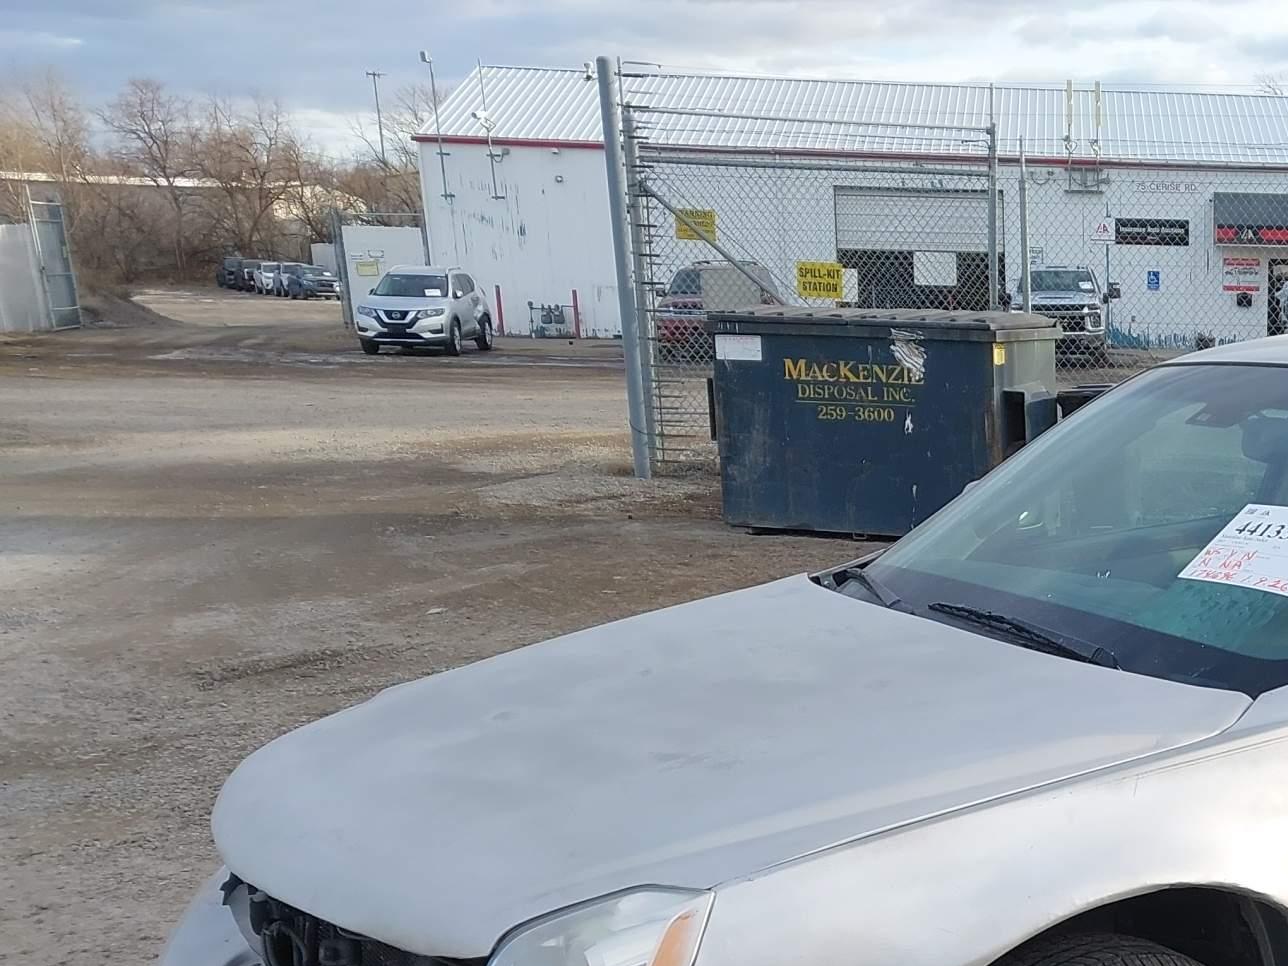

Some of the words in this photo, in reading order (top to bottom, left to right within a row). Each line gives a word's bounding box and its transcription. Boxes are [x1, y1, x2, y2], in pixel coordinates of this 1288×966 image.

[1149, 183, 1181, 192] CERISE
[799, 266, 841, 279] SPILL-KIT
[802, 281, 838, 293] STATION
[797, 383, 878, 401] DISPOSAL
[883, 387, 916, 402] INC.
[817, 405, 895, 422] 259-3600
